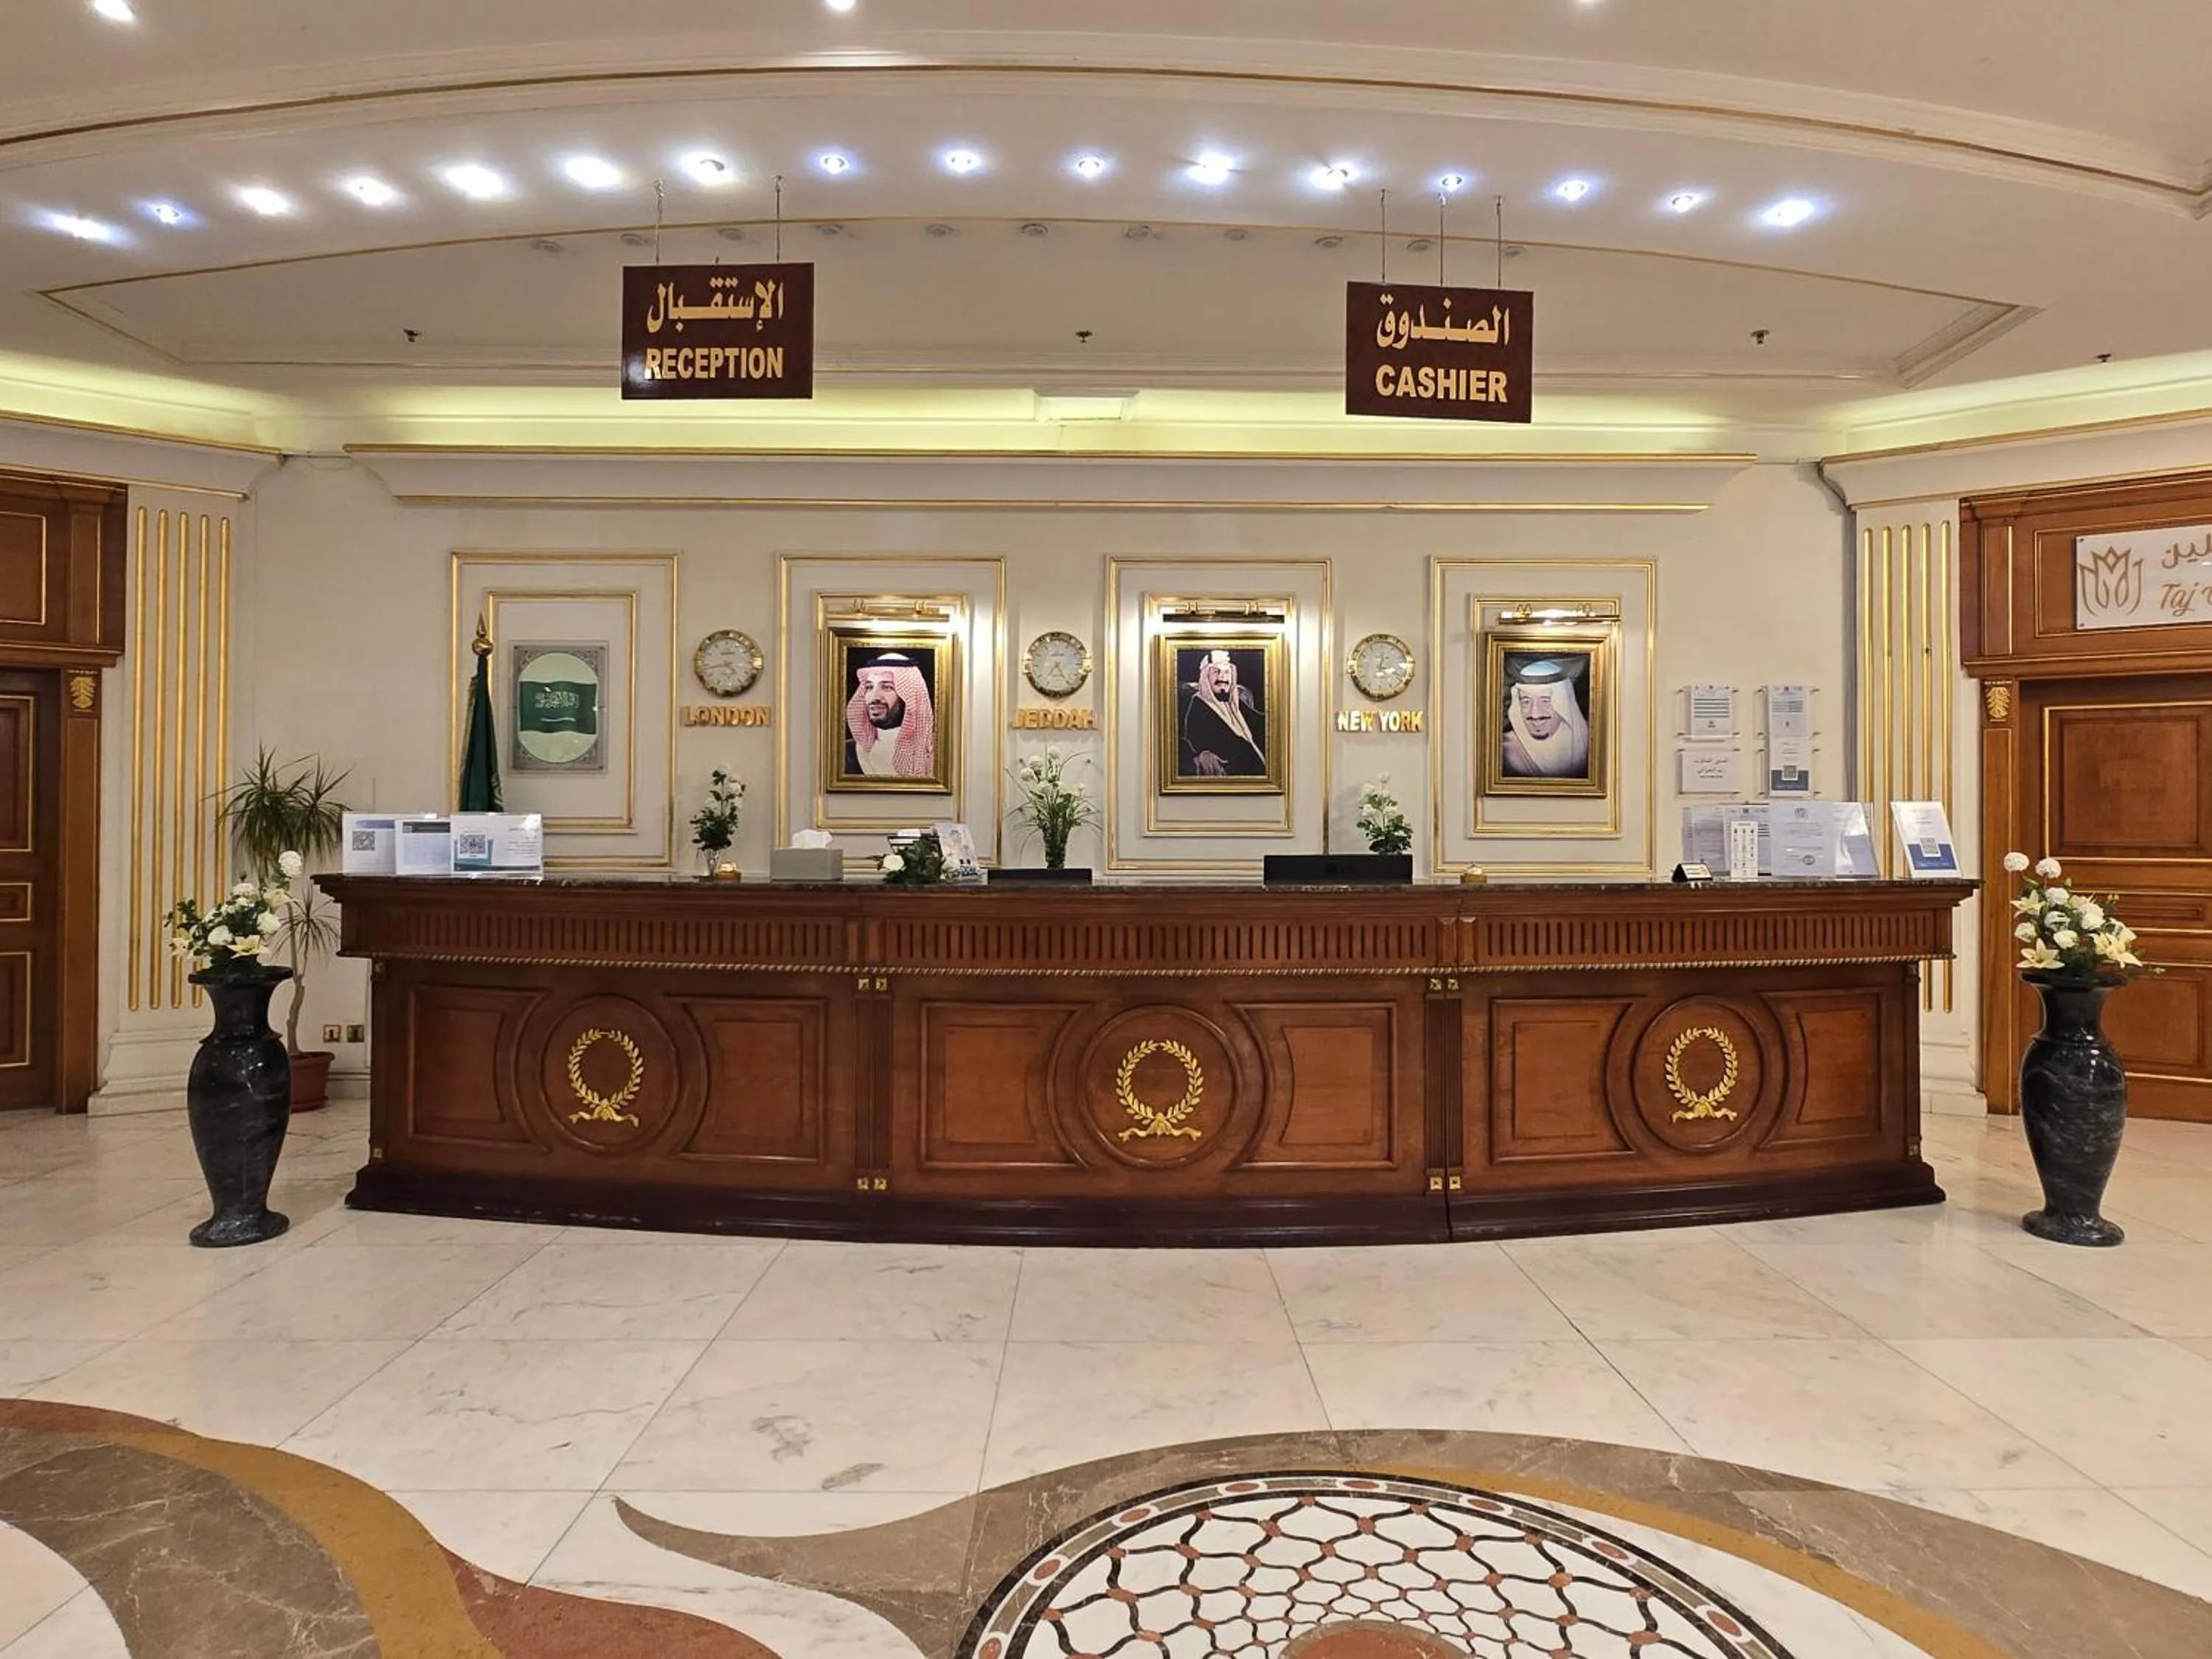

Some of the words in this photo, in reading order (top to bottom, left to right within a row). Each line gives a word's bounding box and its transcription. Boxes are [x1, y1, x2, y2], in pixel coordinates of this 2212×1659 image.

[647, 276, 784, 333] الإستقبال
[1377, 293, 1509, 349] الصندوق
[644, 347, 784, 380] RECEPTION
[1375, 364, 1508, 403] CASHIER
[2160, 582, 2200, 617] Taj
[683, 706, 771, 727] LONDON
[1012, 708, 1097, 729] JEDDAH
[1337, 710, 1375, 731] NEW
[1378, 710, 1424, 731] YORK
